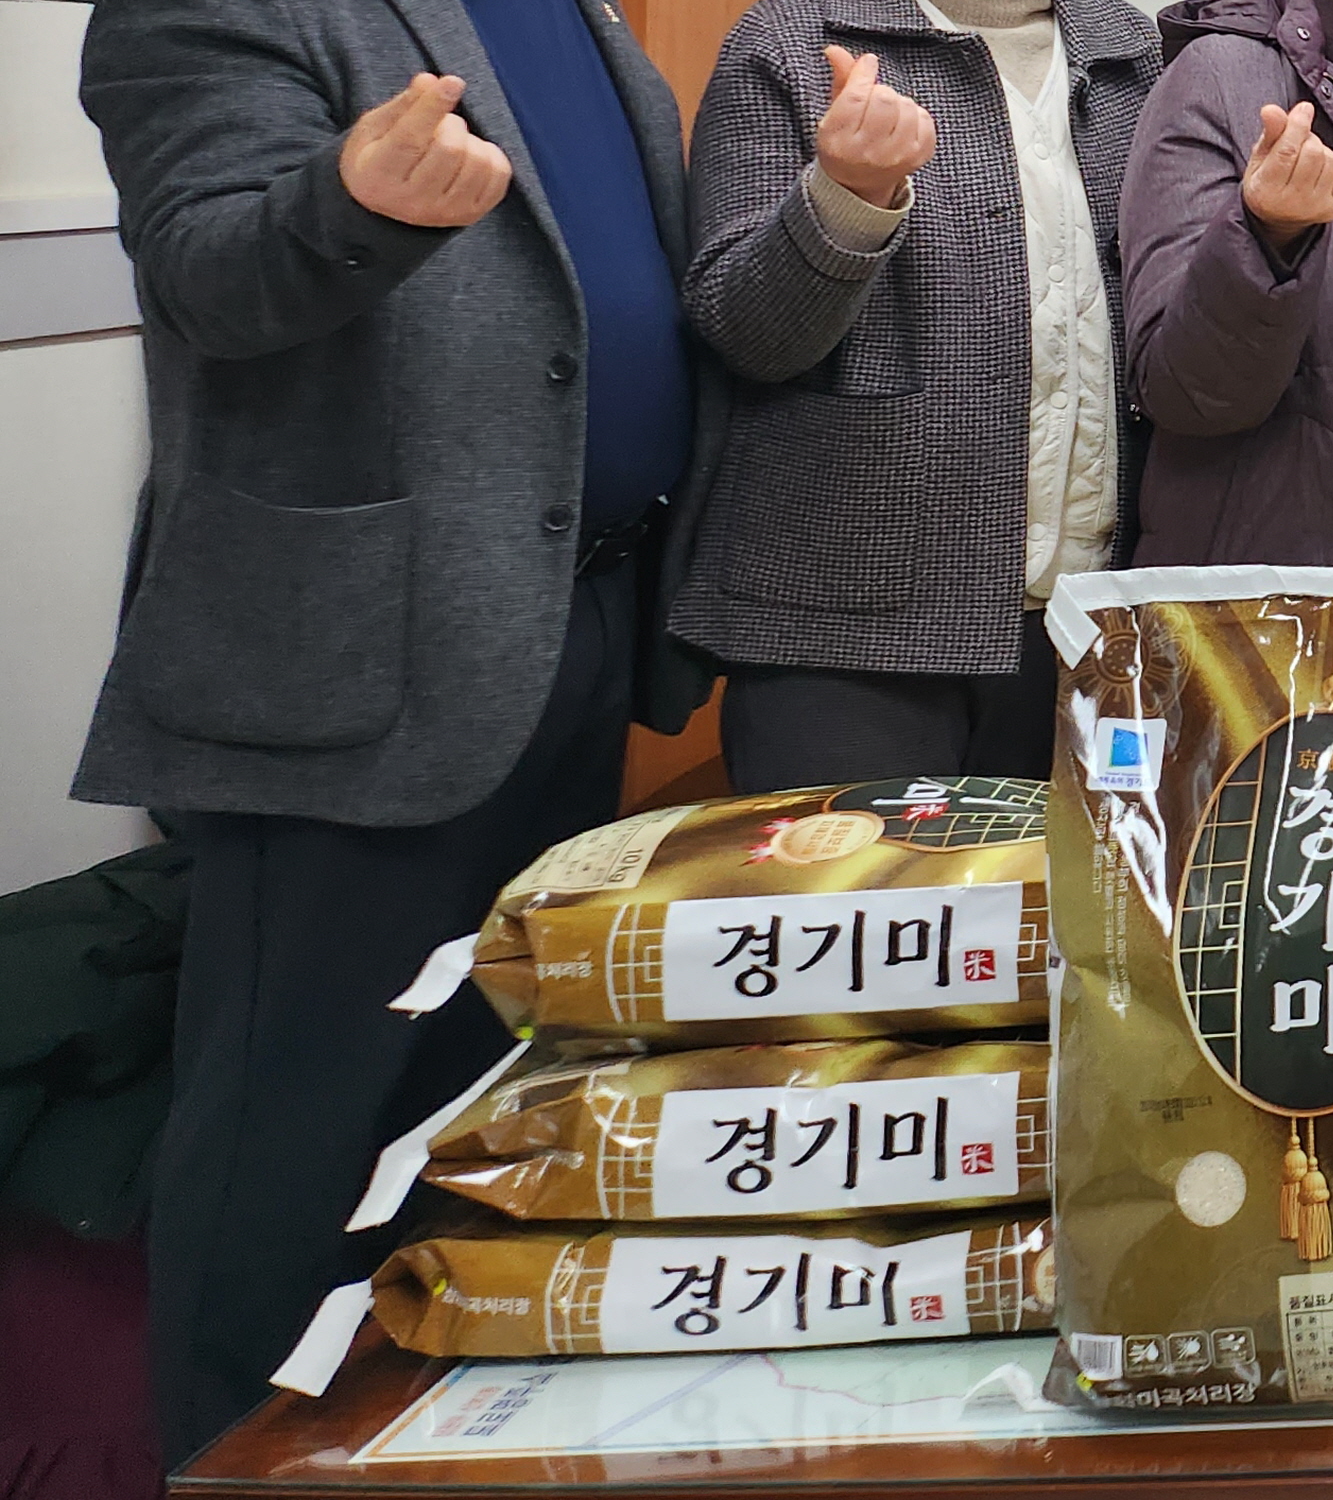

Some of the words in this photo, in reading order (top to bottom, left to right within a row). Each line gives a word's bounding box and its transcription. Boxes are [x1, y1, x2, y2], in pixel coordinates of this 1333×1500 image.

[713, 903, 955, 998] 경기미
[965, 950, 996, 981] 米
[706, 1098, 948, 1194] 경기미
[963, 1143, 994, 1175] 米
[653, 1254, 898, 1336] 경기미
[1113, 1382, 1256, 1409] 미곡처리장
